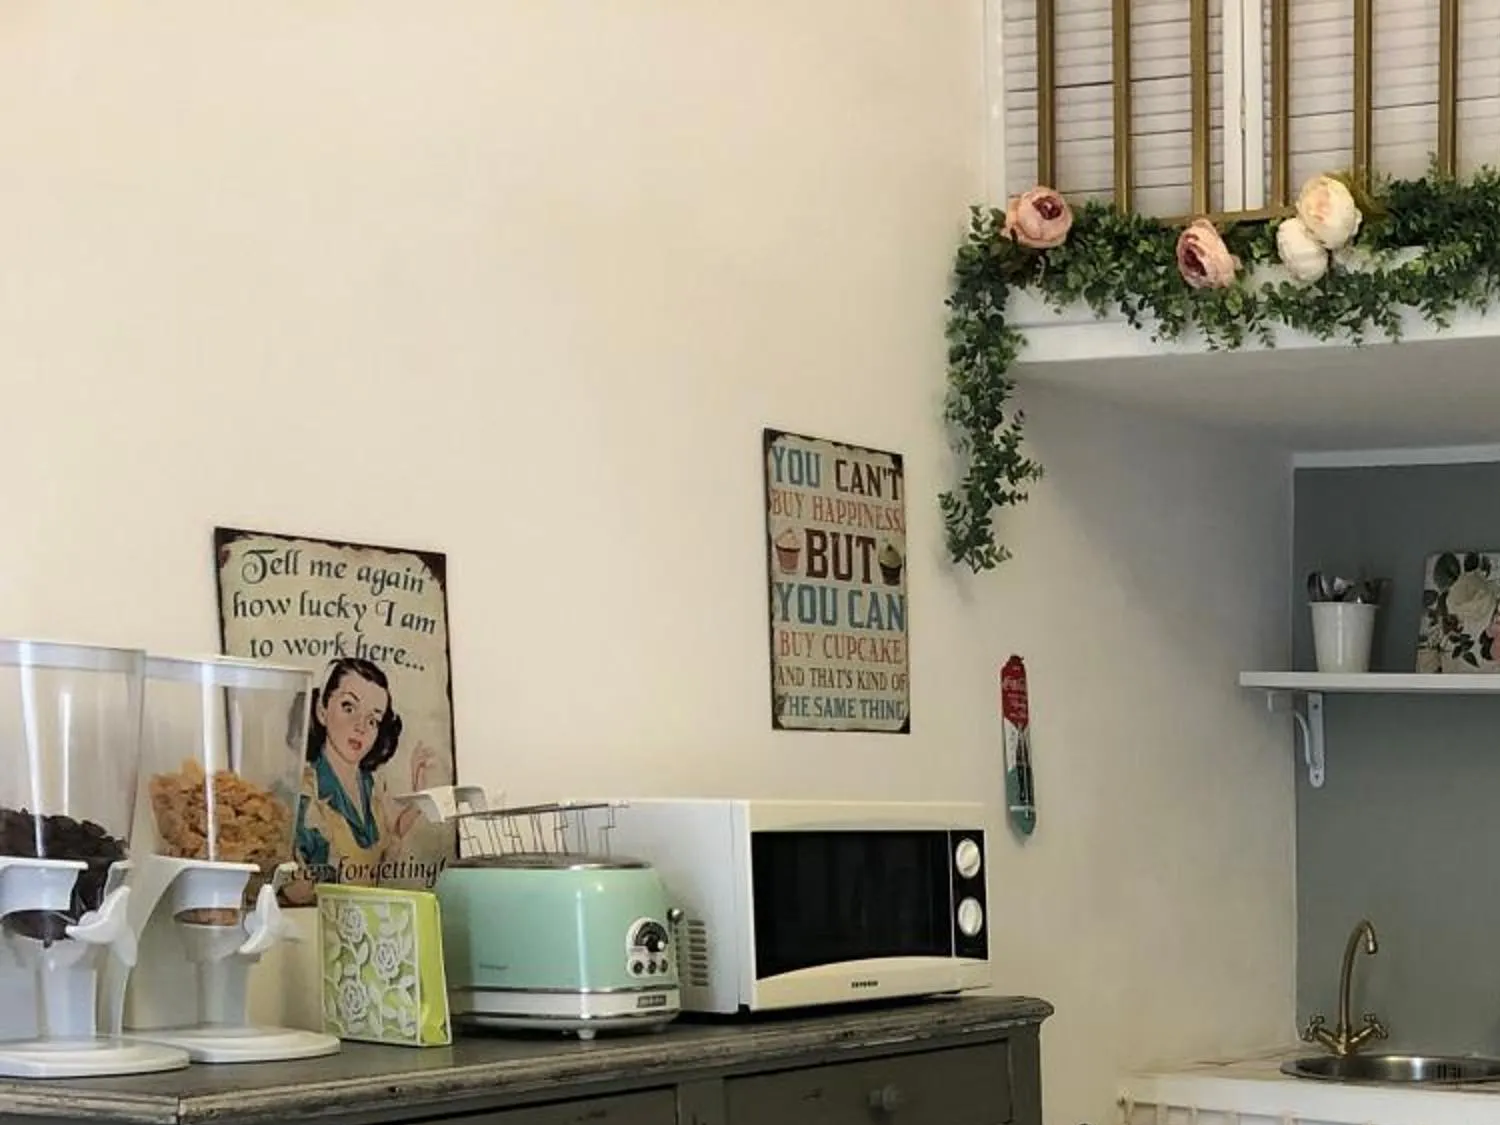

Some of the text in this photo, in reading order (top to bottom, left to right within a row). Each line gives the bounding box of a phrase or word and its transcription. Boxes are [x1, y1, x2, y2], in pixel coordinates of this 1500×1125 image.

[772, 446, 902, 500] YOU CAN'T
[770, 488, 804, 519] BUY
[242, 548, 424, 597] Tell me again
[805, 528, 876, 584] BUT
[233, 589, 436, 635] how lucky I am
[775, 582, 905, 632] YOU CAN
[250, 638, 273, 659] to
[283, 632, 348, 658] work
[779, 631, 904, 664] BUY CUPCAKE
[777, 666, 908, 691] AND THAT'S KIND OF
[813, 696, 856, 718] SAME
[860, 699, 905, 720] THING
